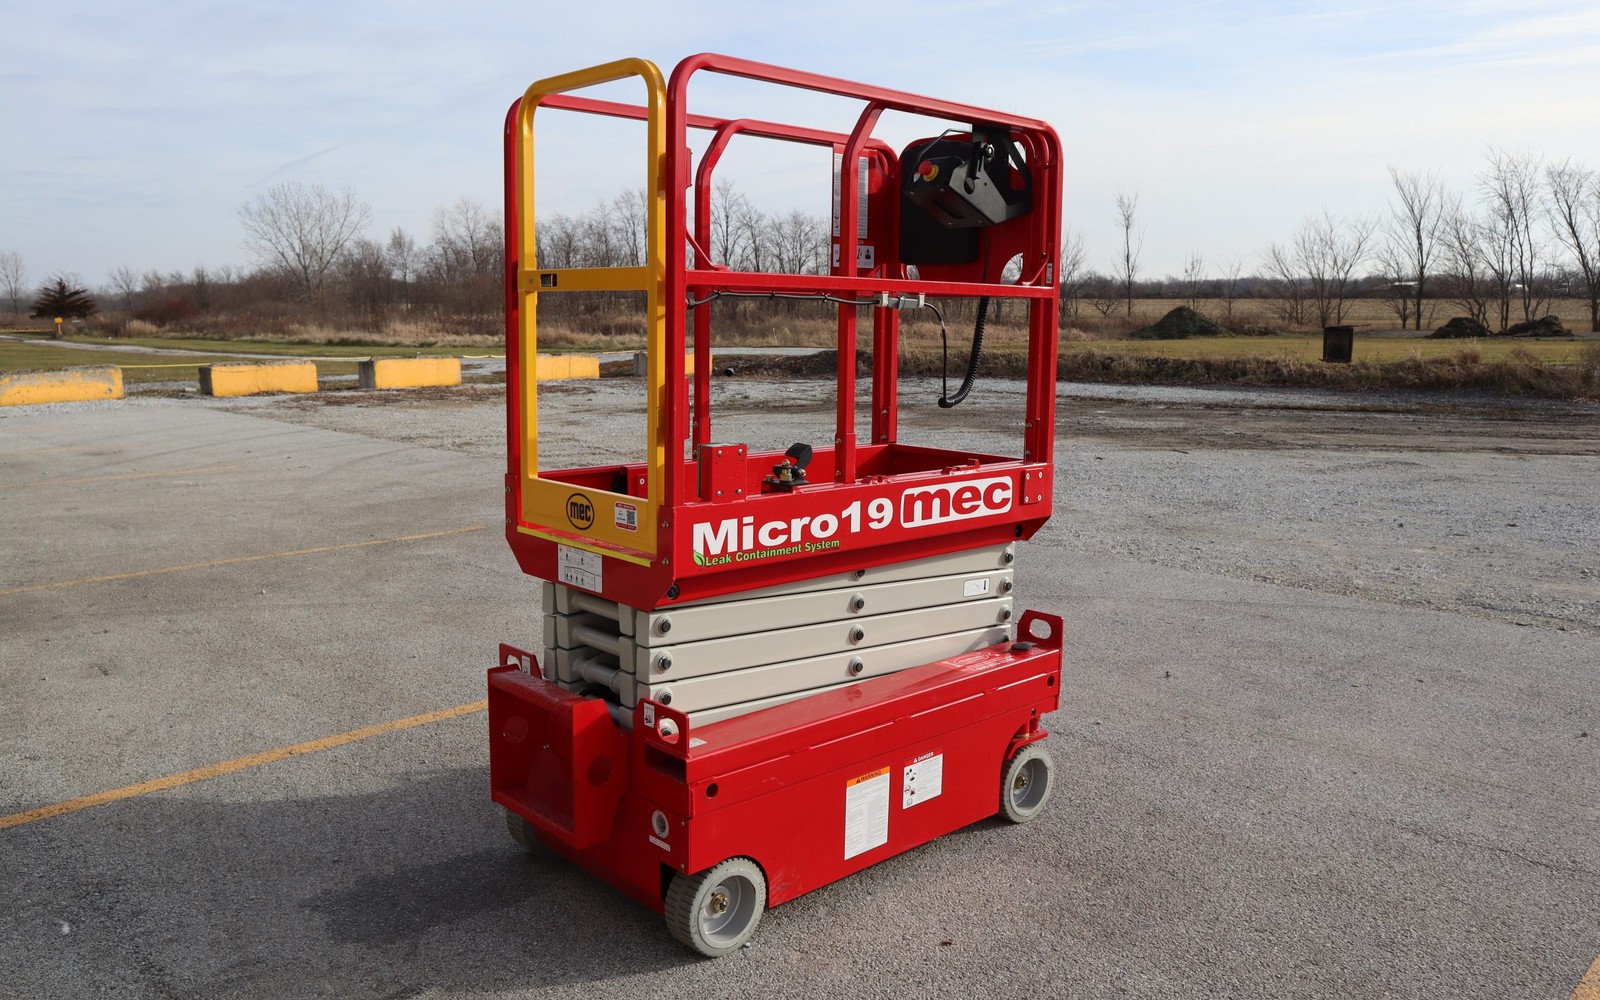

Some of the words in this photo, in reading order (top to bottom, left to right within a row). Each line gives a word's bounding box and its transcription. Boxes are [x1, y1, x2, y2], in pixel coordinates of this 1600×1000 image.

[569, 501, 592, 523] mec
[904, 483, 1012, 524] mec
[705, 554, 732, 567] Leak
[735, 544, 802, 562] Containment
[805, 539, 840, 553] System
[917, 751, 934, 762] DANGER
[860, 769, 882, 781] WARNING
